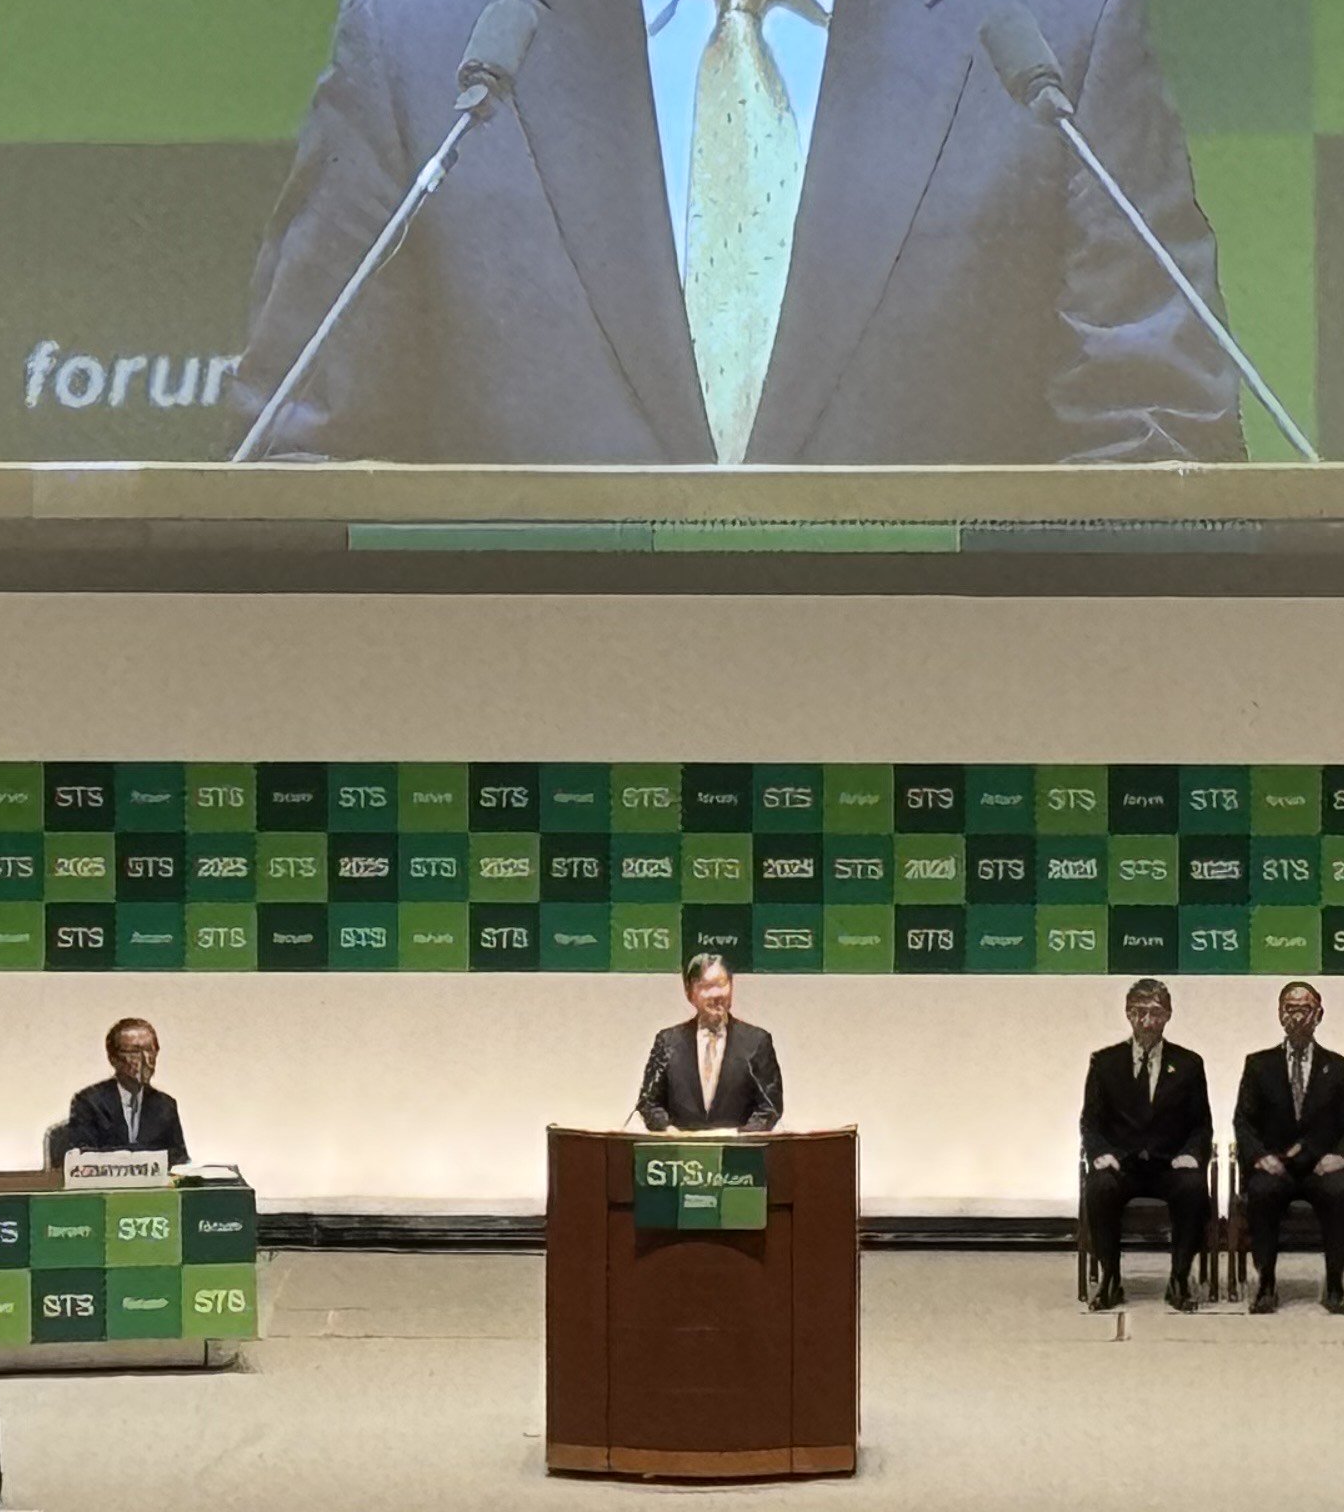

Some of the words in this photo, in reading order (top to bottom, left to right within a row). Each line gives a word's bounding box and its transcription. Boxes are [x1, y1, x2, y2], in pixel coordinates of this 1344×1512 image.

[647, 1160, 704, 1187] STS
[118, 1217, 170, 1240] STS
[44, 1294, 94, 1316] STS
[195, 1289, 246, 1313] STS
